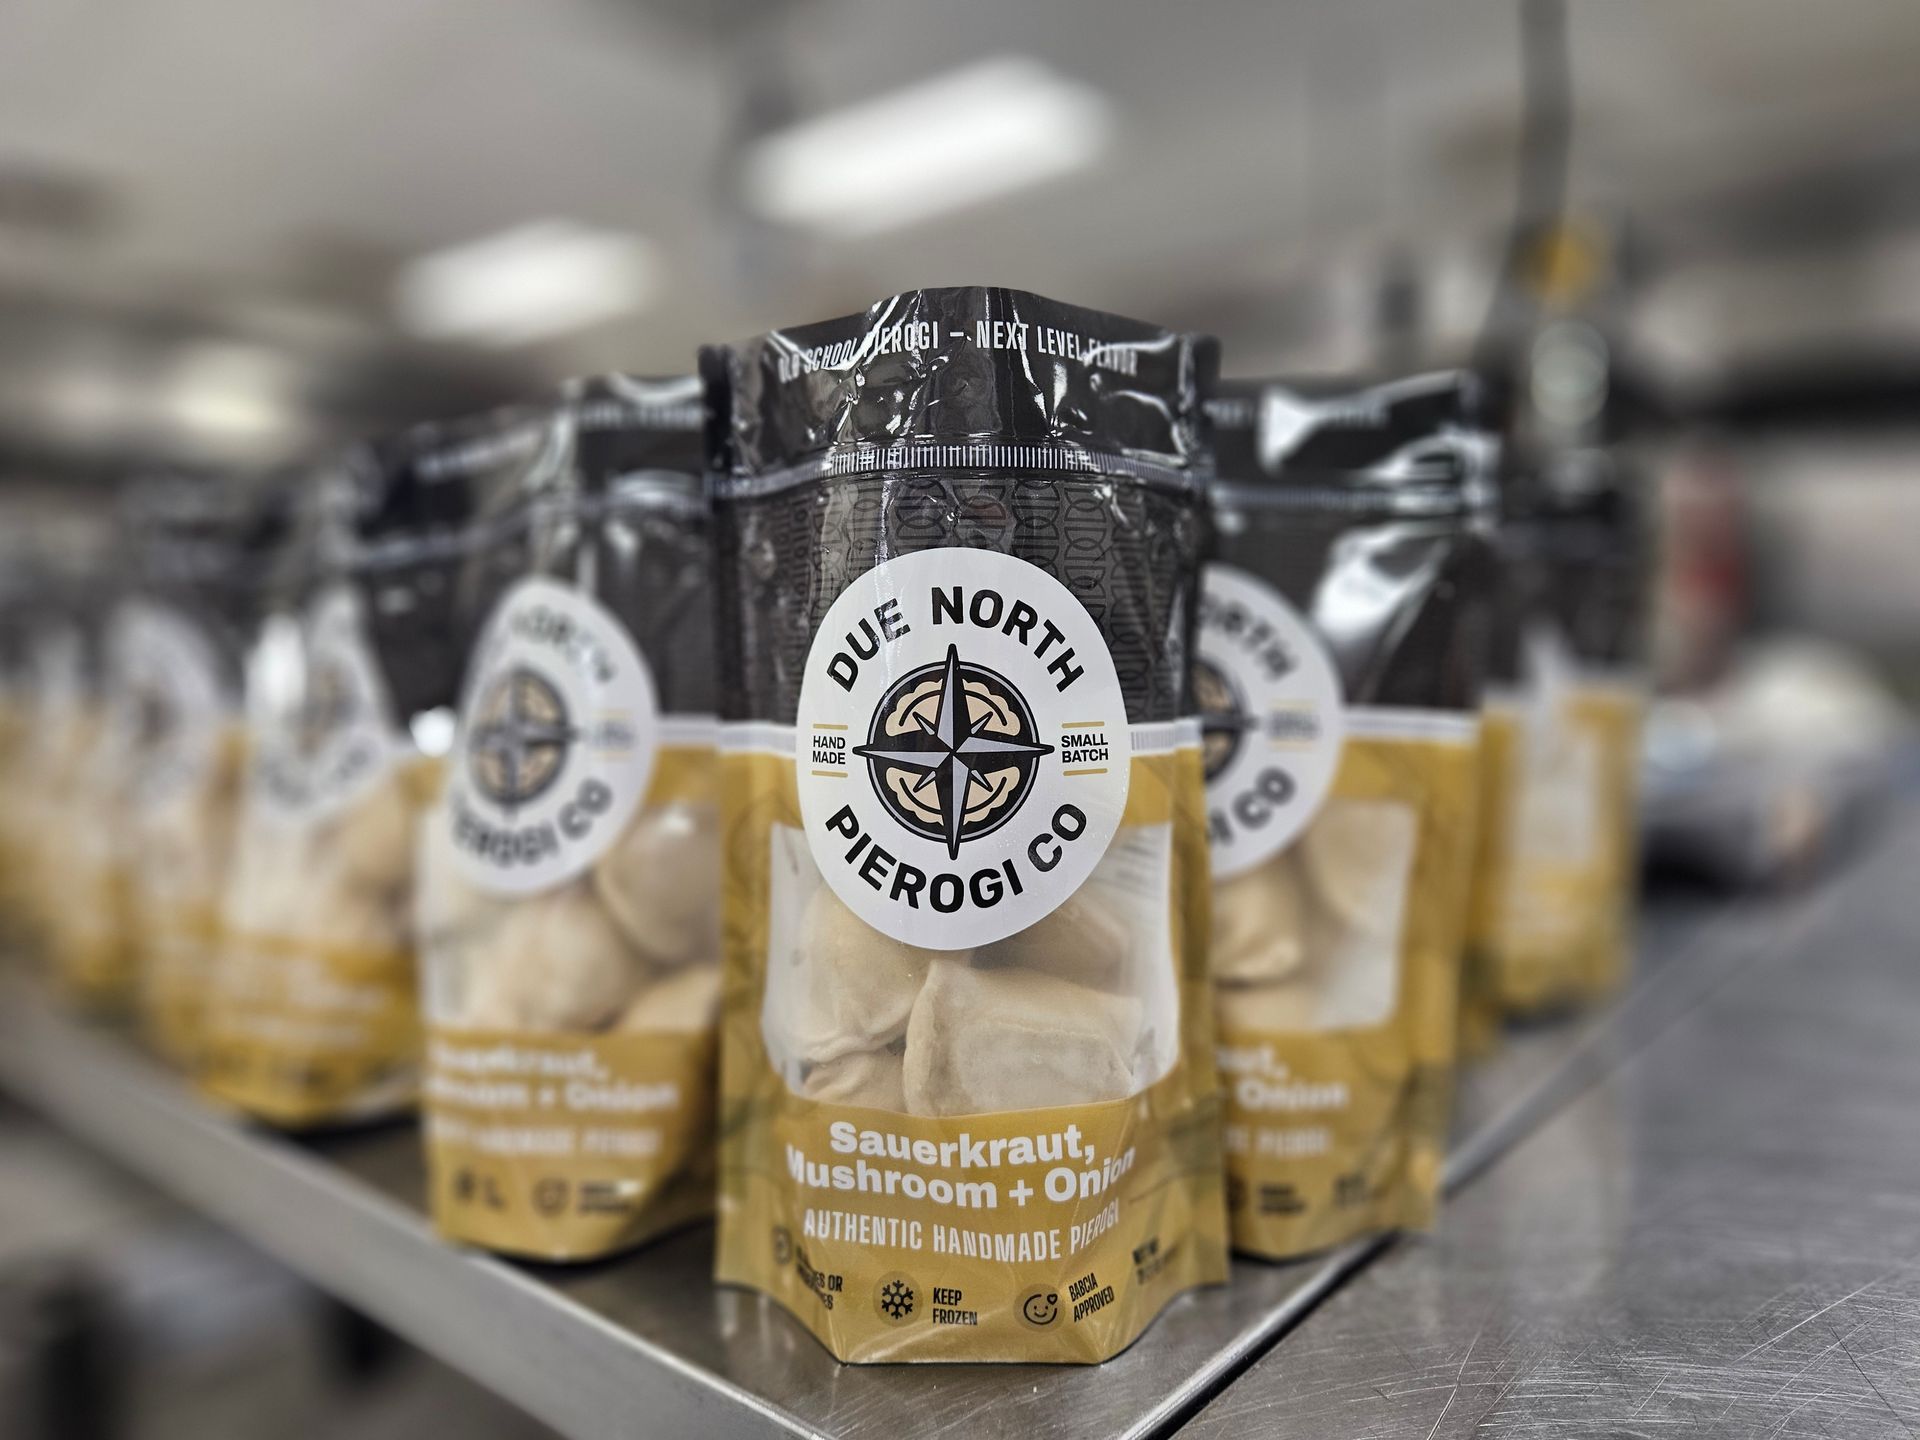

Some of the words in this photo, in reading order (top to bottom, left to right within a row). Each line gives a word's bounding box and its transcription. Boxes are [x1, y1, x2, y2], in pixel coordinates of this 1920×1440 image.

[976, 320, 1029, 350] NEXT
[1037, 325, 1083, 361] LEVEL
[826, 597, 911, 693] DUE
[931, 586, 1085, 693] NORTH
[812, 735, 846, 750] HAND
[812, 750, 846, 765] MADE
[1061, 733, 1108, 748] SMALL
[1061, 748, 1109, 764] BATCH
[558, 777, 613, 841] CO
[1231, 766, 1298, 830] CO
[825, 804, 1023, 913] PIEROGI
[1027, 803, 1087, 873] CO
[830, 1121, 1095, 1168] Sauerkraut,
[786, 1143, 998, 1209] Mushroom
[1008, 1179, 1034, 1207] +
[1044, 1146, 1136, 1202] Onion
[804, 1208, 923, 1250] AUTHENTIC
[933, 1223, 1062, 1263] HANDMADE
[1070, 1197, 1120, 1256] PIEROGI
[828, 1274, 843, 1292] OR
[933, 1287, 962, 1306] KEEP
[1068, 1272, 1098, 1302] BABCIA
[932, 1308, 978, 1326] FROZEN
[1073, 1285, 1115, 1323] APPROVED
